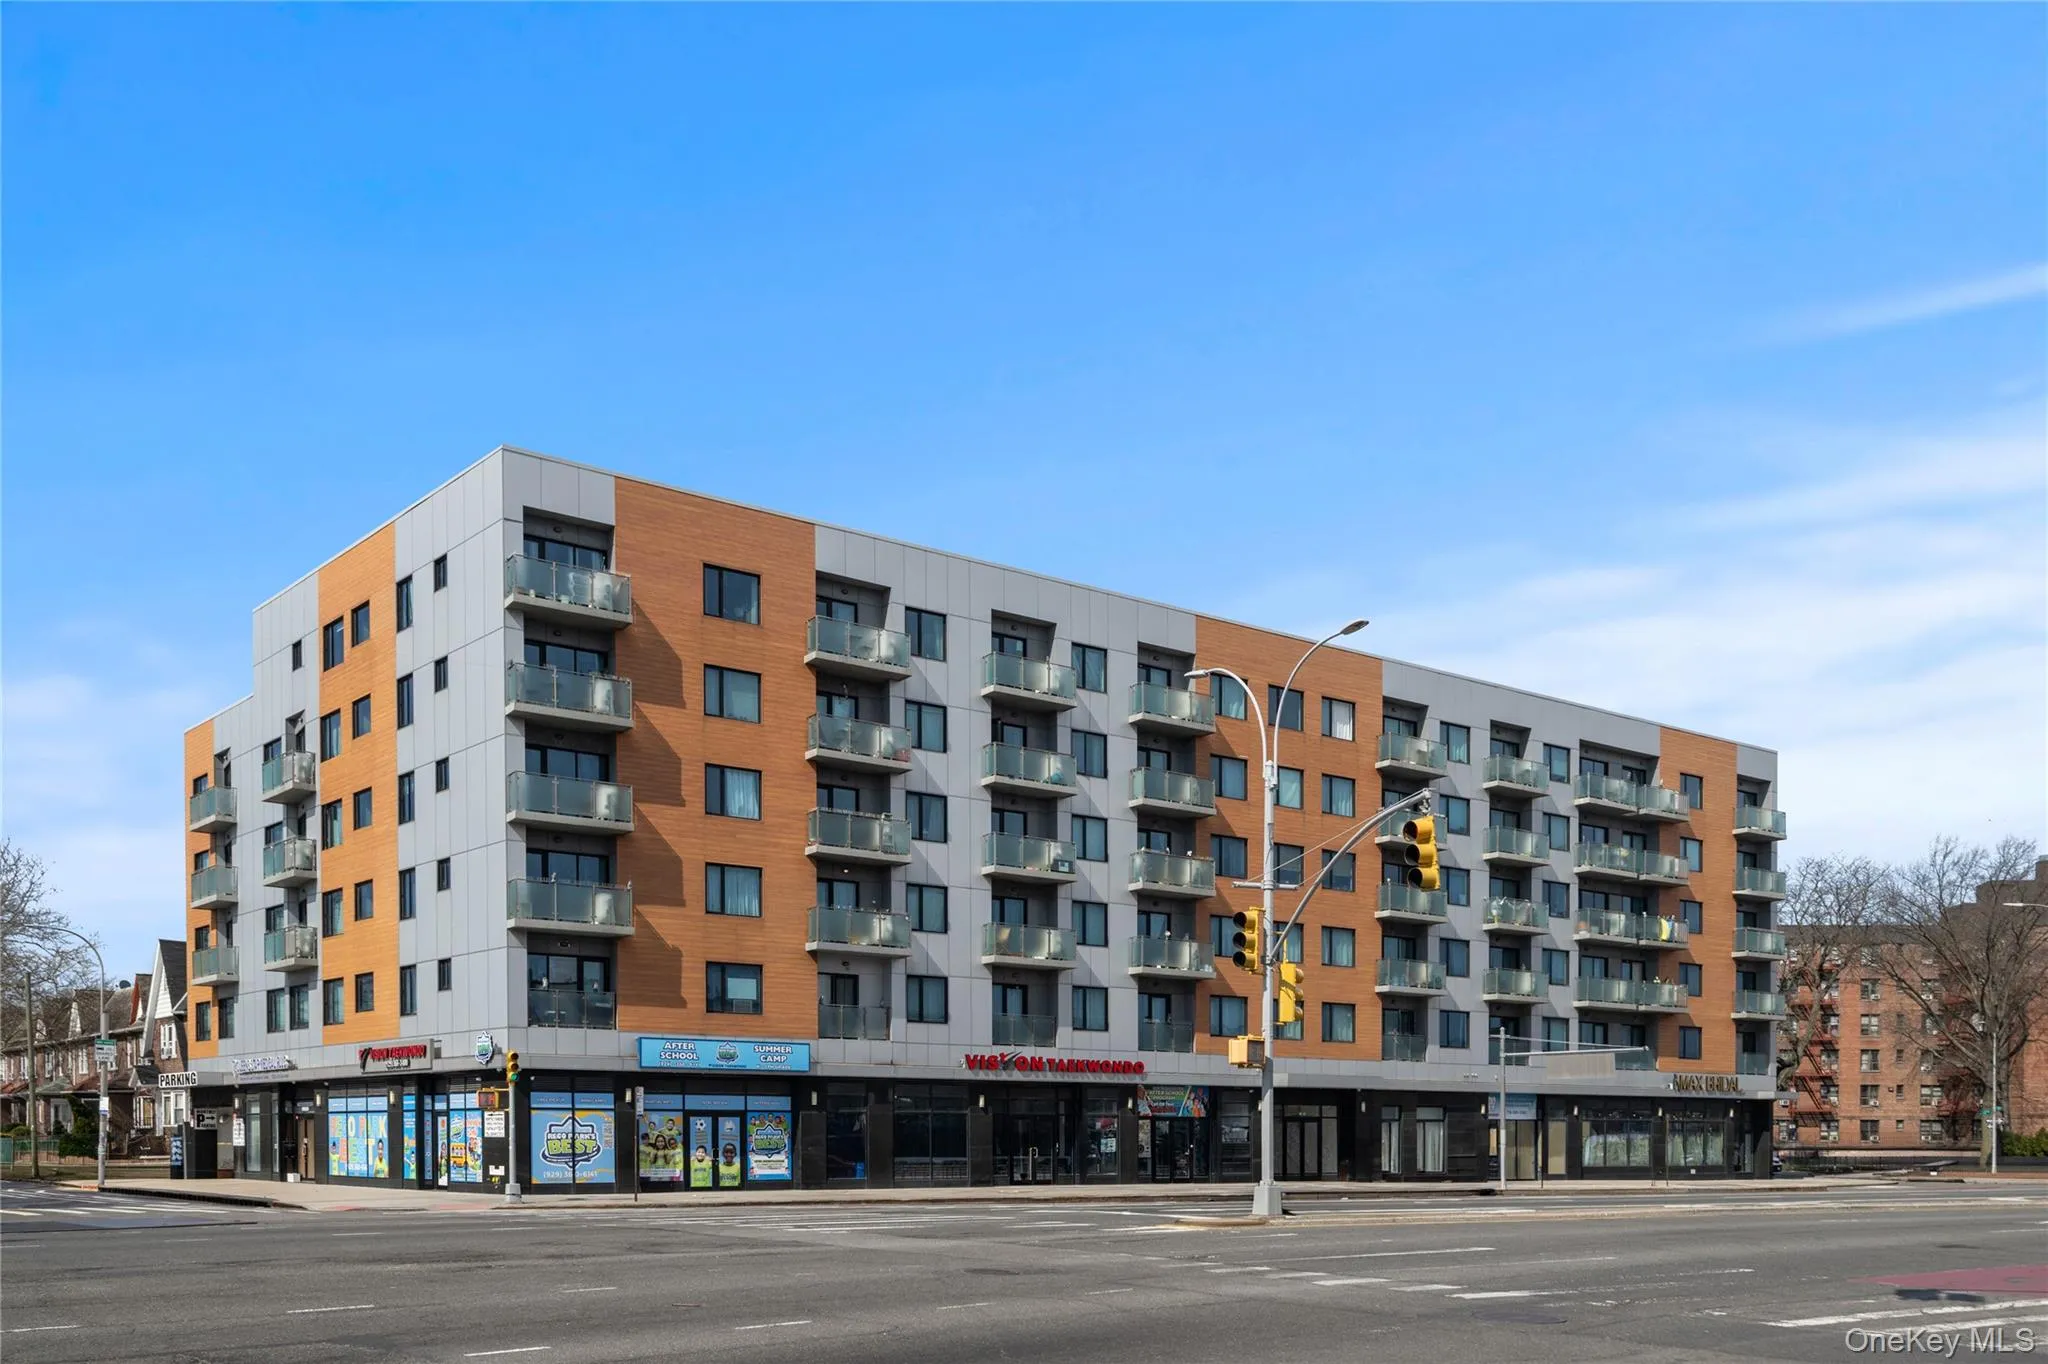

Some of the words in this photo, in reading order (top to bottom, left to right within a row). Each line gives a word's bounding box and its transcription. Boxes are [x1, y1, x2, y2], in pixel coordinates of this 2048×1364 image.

[664, 1041, 696, 1050] AFTER
[753, 1044, 793, 1054] SUMMER
[660, 1051, 699, 1060] SCHOOL
[760, 1054, 788, 1063] CAMP
[1046, 1058, 1145, 1074] TAEKWONDO
[160, 1072, 197, 1087] PARKING
[1705, 1075, 1740, 1092] BRIDAL
[547, 1139, 597, 1155] BEST
